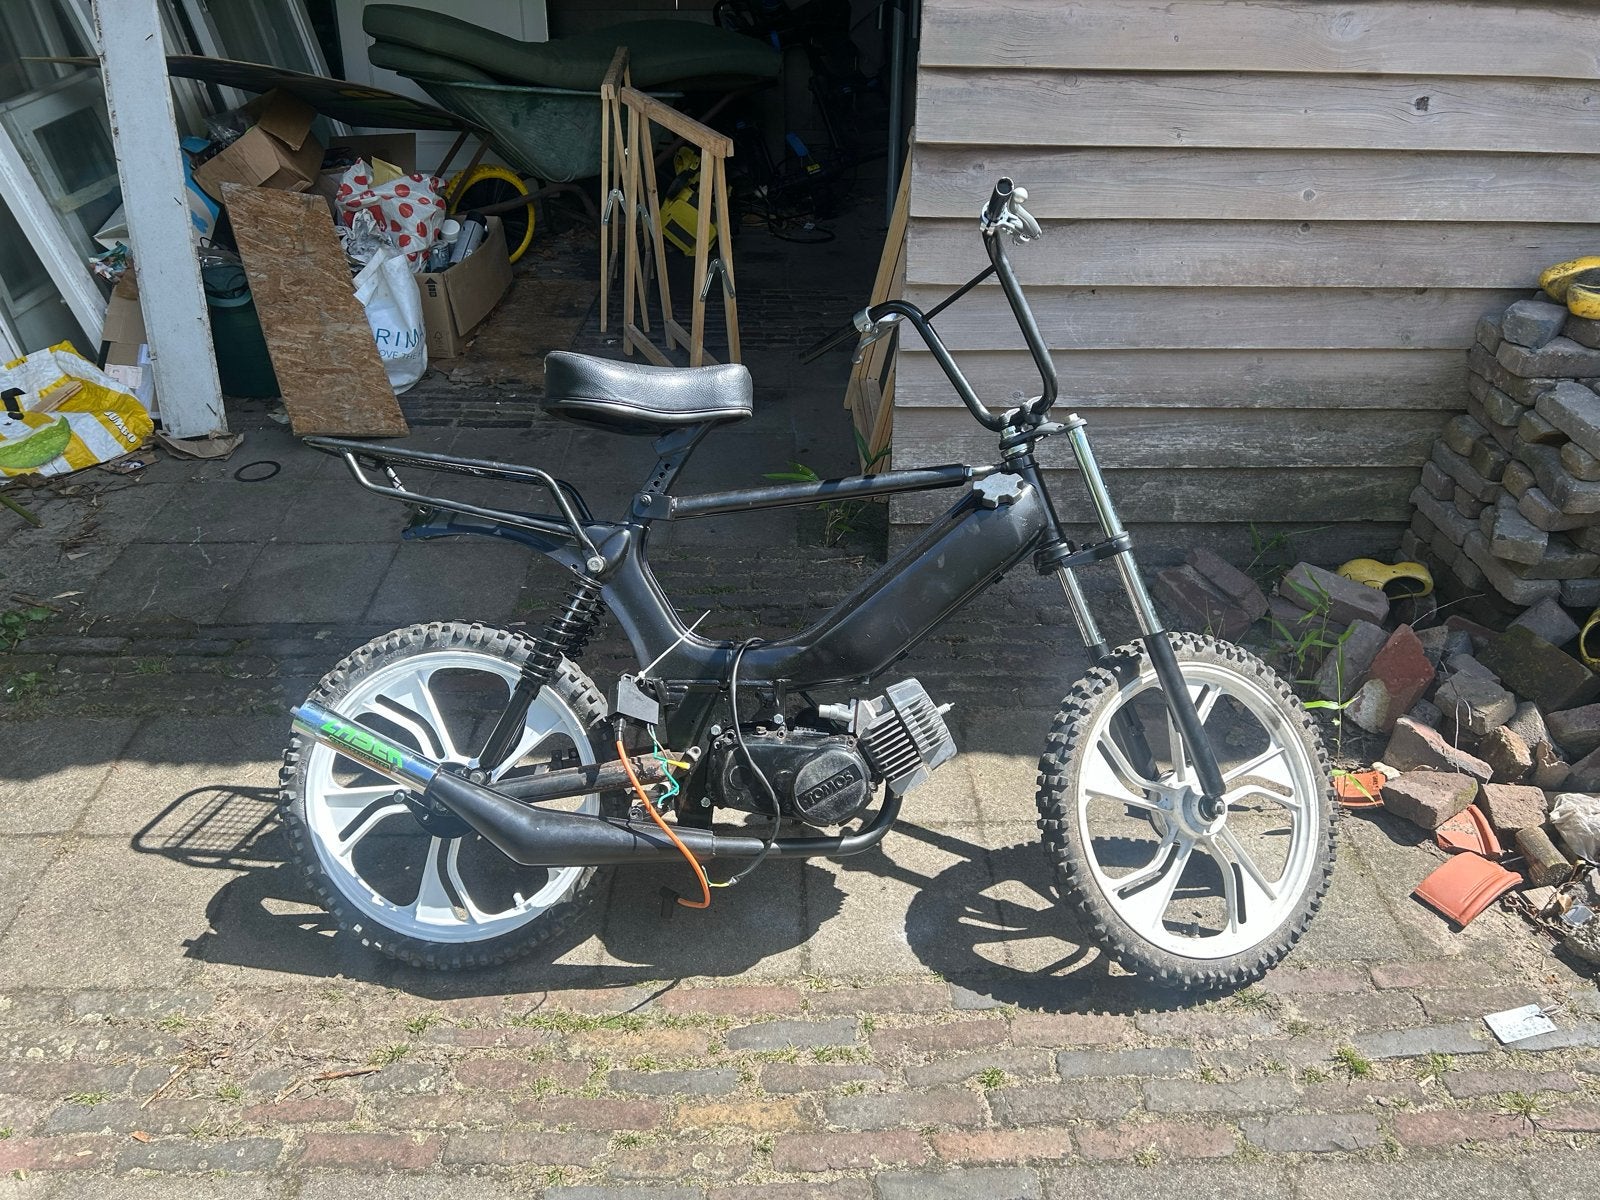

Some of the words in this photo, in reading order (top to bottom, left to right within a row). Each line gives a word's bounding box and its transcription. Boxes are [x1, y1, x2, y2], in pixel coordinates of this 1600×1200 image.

[379, 349, 399, 359] OVE
[104, 411, 137, 443] JUMBO
[804, 770, 855, 806] TOMOS
